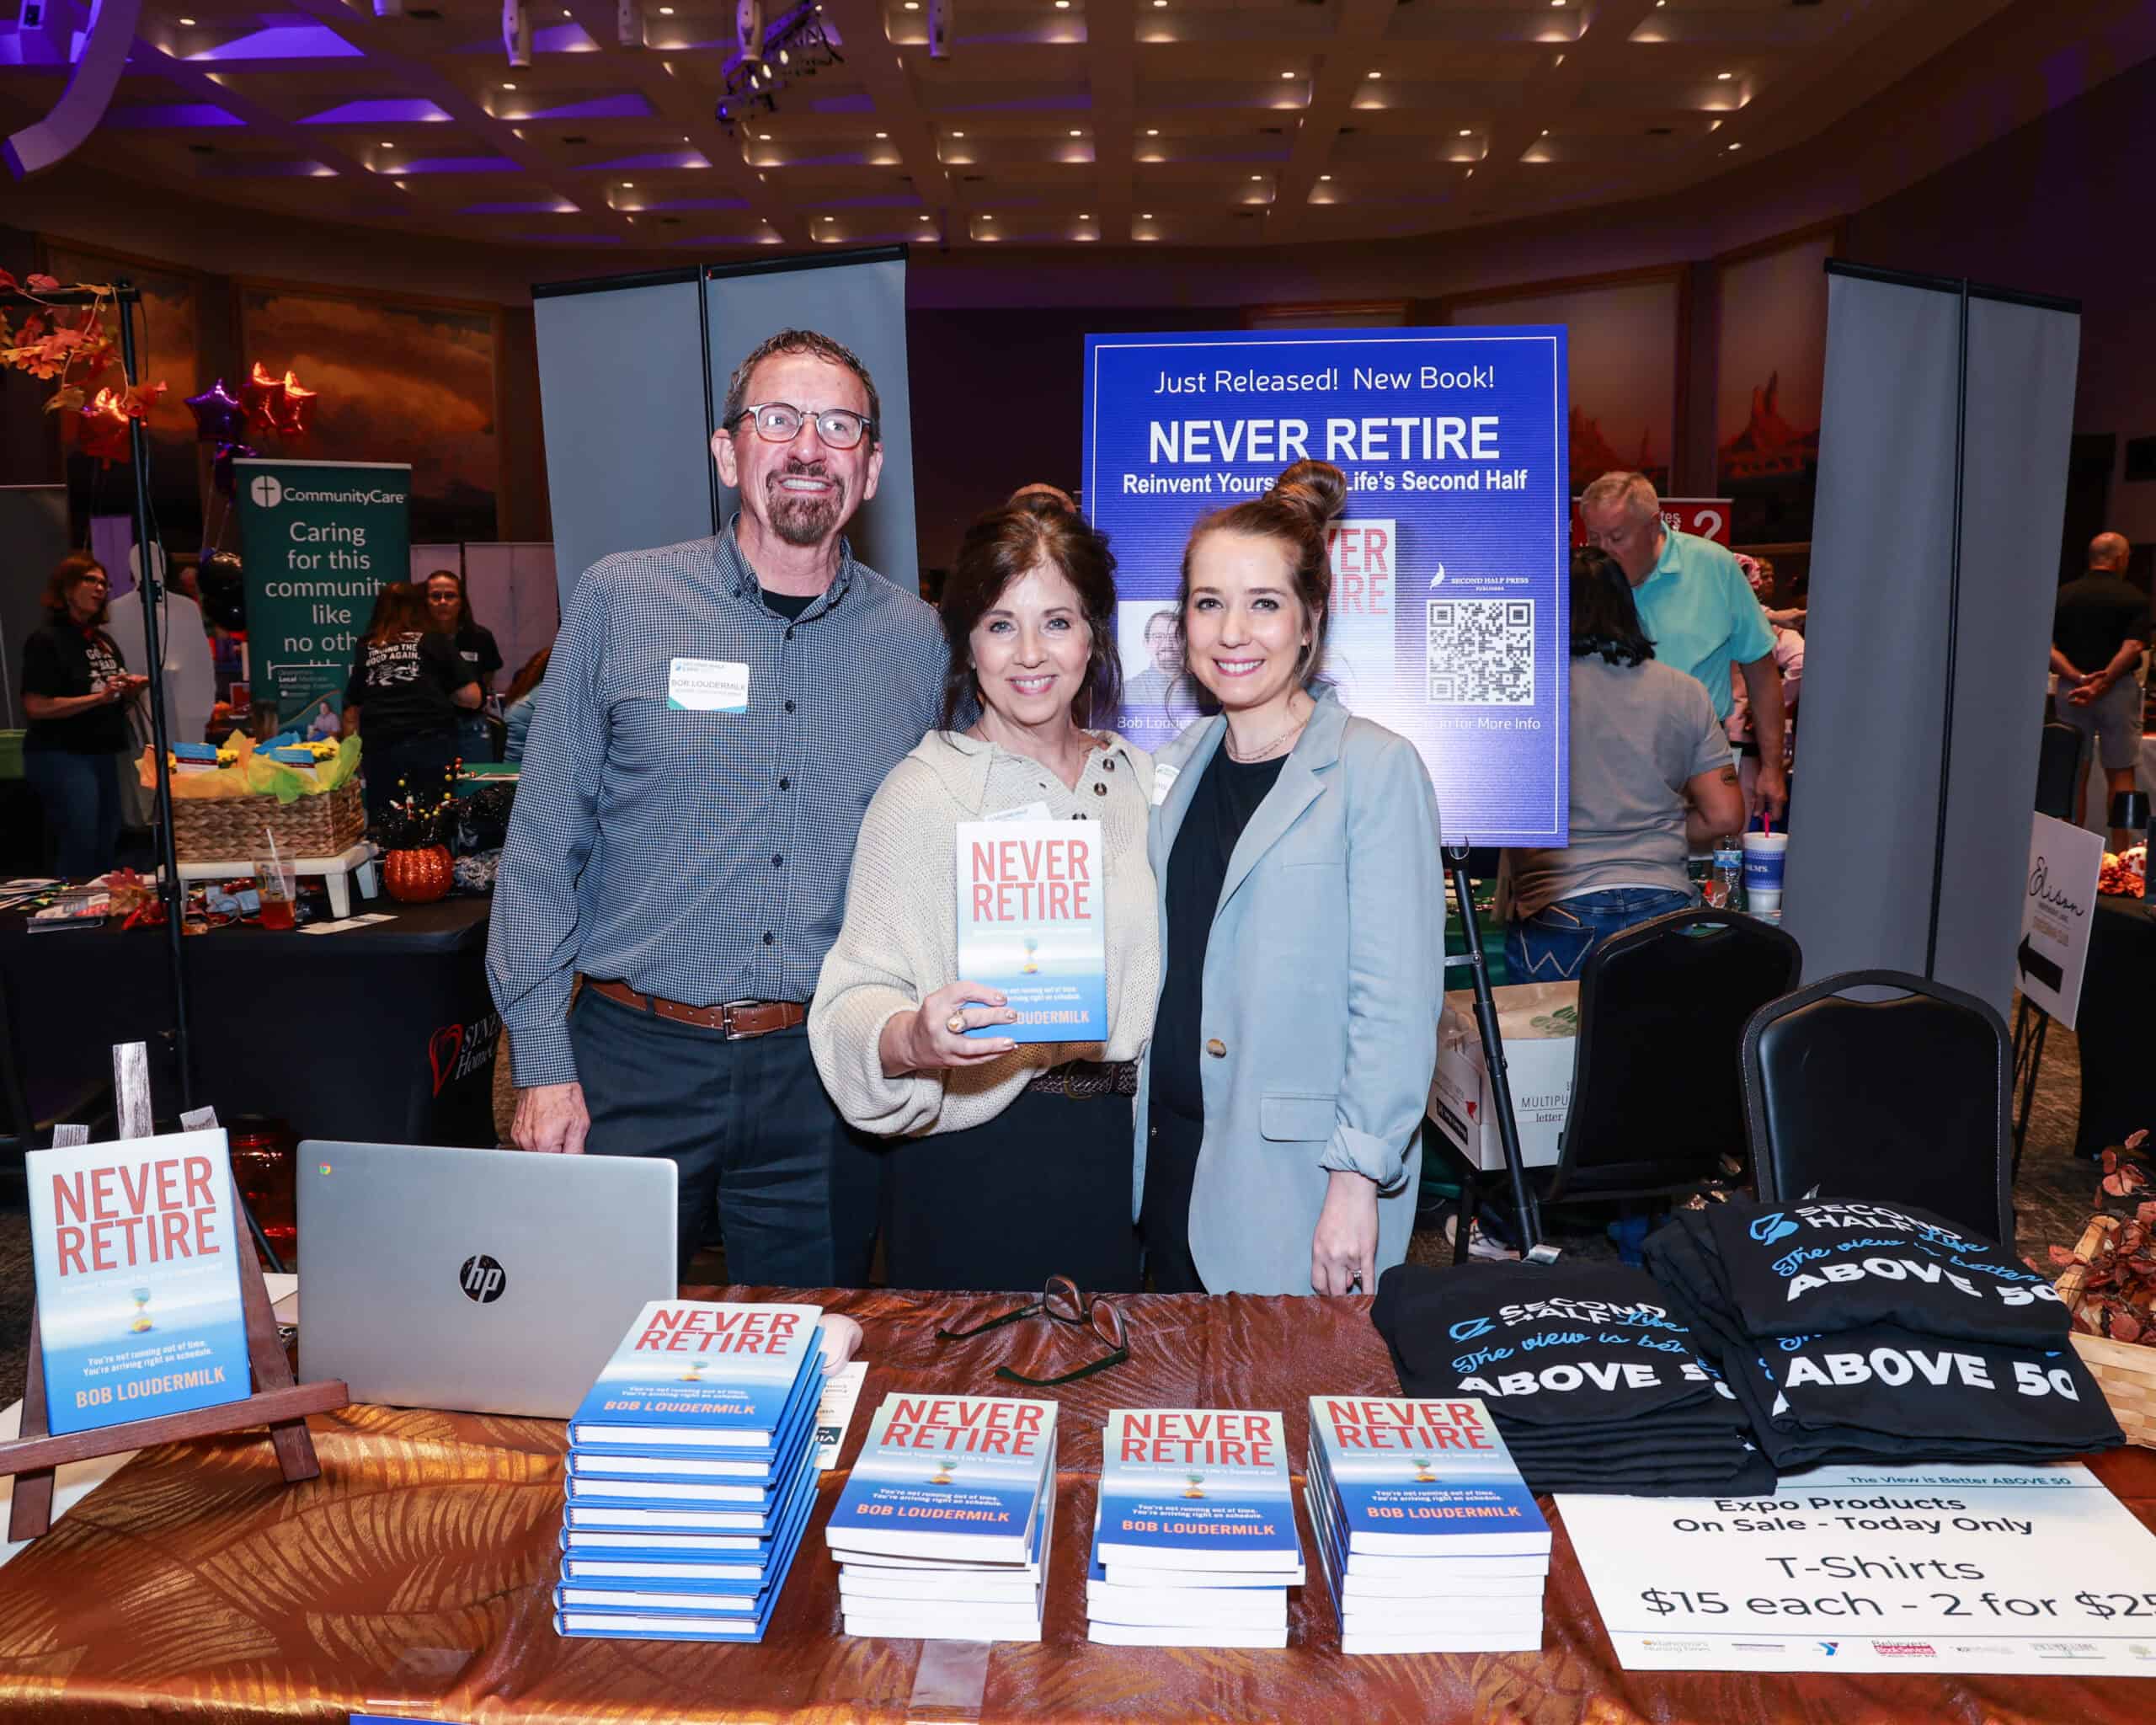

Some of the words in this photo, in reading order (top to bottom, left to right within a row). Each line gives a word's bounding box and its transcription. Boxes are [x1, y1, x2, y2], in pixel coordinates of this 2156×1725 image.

[1155, 371, 1206, 393] Just
[1215, 367, 1338, 393] Released!
[1353, 367, 1412, 390] New
[1421, 365, 1494, 389] Book!
[1150, 419, 1310, 463] NEVER
[1326, 416, 1500, 461] RETIRE
[1123, 473, 1212, 494] Reinvent
[1217, 472, 1279, 492] Yours
[1401, 469, 1479, 491] Second
[1486, 468, 1528, 490] Half
[283, 487, 405, 506] CommunityCare
[289, 521, 366, 547] Caring
[287, 549, 321, 569] for
[328, 549, 371, 569] this
[1326, 528, 1388, 573] VER
[265, 576, 387, 597] communit
[1328, 574, 1388, 614] IRE
[312, 604, 351, 624] like
[284, 636, 313, 652] no
[321, 630, 358, 651] oth
[1117, 716, 1143, 729] Bob
[1478, 718, 1513, 729] More
[1516, 717, 1541, 729] Info
[972, 840, 1090, 882] NEVER
[973, 881, 1092, 921] RETIRE
[1013, 1010, 1091, 1025] OUDERMILK
[1521, 1095, 1569, 1108] MULTIPU
[1536, 1111, 1564, 1124] letter
[52, 1156, 216, 1226] NEVER
[1795, 1204, 1964, 1240] SECOND
[1804, 1215, 1914, 1232] HALF
[56, 1206, 220, 1276] RETIRE
[1772, 1247, 1831, 1277] The
[1837, 1237, 1906, 1252] view
[1950, 1255, 2043, 1282] better
[465, 1253, 503, 1304] hp
[1786, 1258, 1983, 1301] ABOVE
[1996, 1284, 2063, 1306] 50
[1499, 1297, 1668, 1319] SECOND
[1502, 1306, 1611, 1327] HALF
[647, 1309, 801, 1335] NEVER
[633, 1330, 794, 1355] RETIRE
[1452, 1347, 1514, 1374] The
[1522, 1332, 1591, 1351] view
[1599, 1331, 1631, 1343] is
[75, 1386, 112, 1408] BOB
[117, 1365, 226, 1401] LOUDERMILK
[1457, 1361, 1662, 1397] ABOVE
[1785, 1348, 1995, 1390] ABOVE
[2013, 1361, 2080, 1402] 50
[604, 1401, 641, 1411] BOB
[644, 1401, 755, 1415] LOUDERMILK
[892, 1399, 1044, 1431] NEVER
[1326, 1401, 1482, 1426] NEVER
[880, 1423, 1039, 1456] RETIRE
[1123, 1414, 1273, 1441] NEVER
[1335, 1425, 1494, 1450] RETIRE
[1120, 1439, 1275, 1466] RETIRE
[1848, 1476, 1877, 1484] The
[1879, 1476, 1919, 1484] View
[1939, 1476, 1988, 1485] Better
[1993, 1477, 2048, 1485] ABOVE
[2050, 1477, 2072, 1485] 50
[857, 1503, 894, 1515] BOB
[897, 1504, 1010, 1522] LOUDERMILK
[1367, 1507, 1403, 1519] BOB
[1408, 1506, 1522, 1519] LOUDERMILK
[1714, 1498, 1801, 1515] Expo
[1808, 1495, 1967, 1511] Products
[1122, 1519, 1158, 1532] BOB
[1163, 1521, 1275, 1535] LOUDERMILK
[1673, 1519, 1725, 1533] On
[1732, 1517, 1806, 1532] Sale
[1834, 1516, 1941, 1535] Today
[1951, 1516, 2035, 1535] Only
[1765, 1556, 1985, 1581] T-Shirts
[1641, 1587, 1730, 1616] $15
[1746, 1591, 1885, 1616] each
[1929, 1593, 1973, 1616] 2
[1979, 1592, 2057, 1616] for
